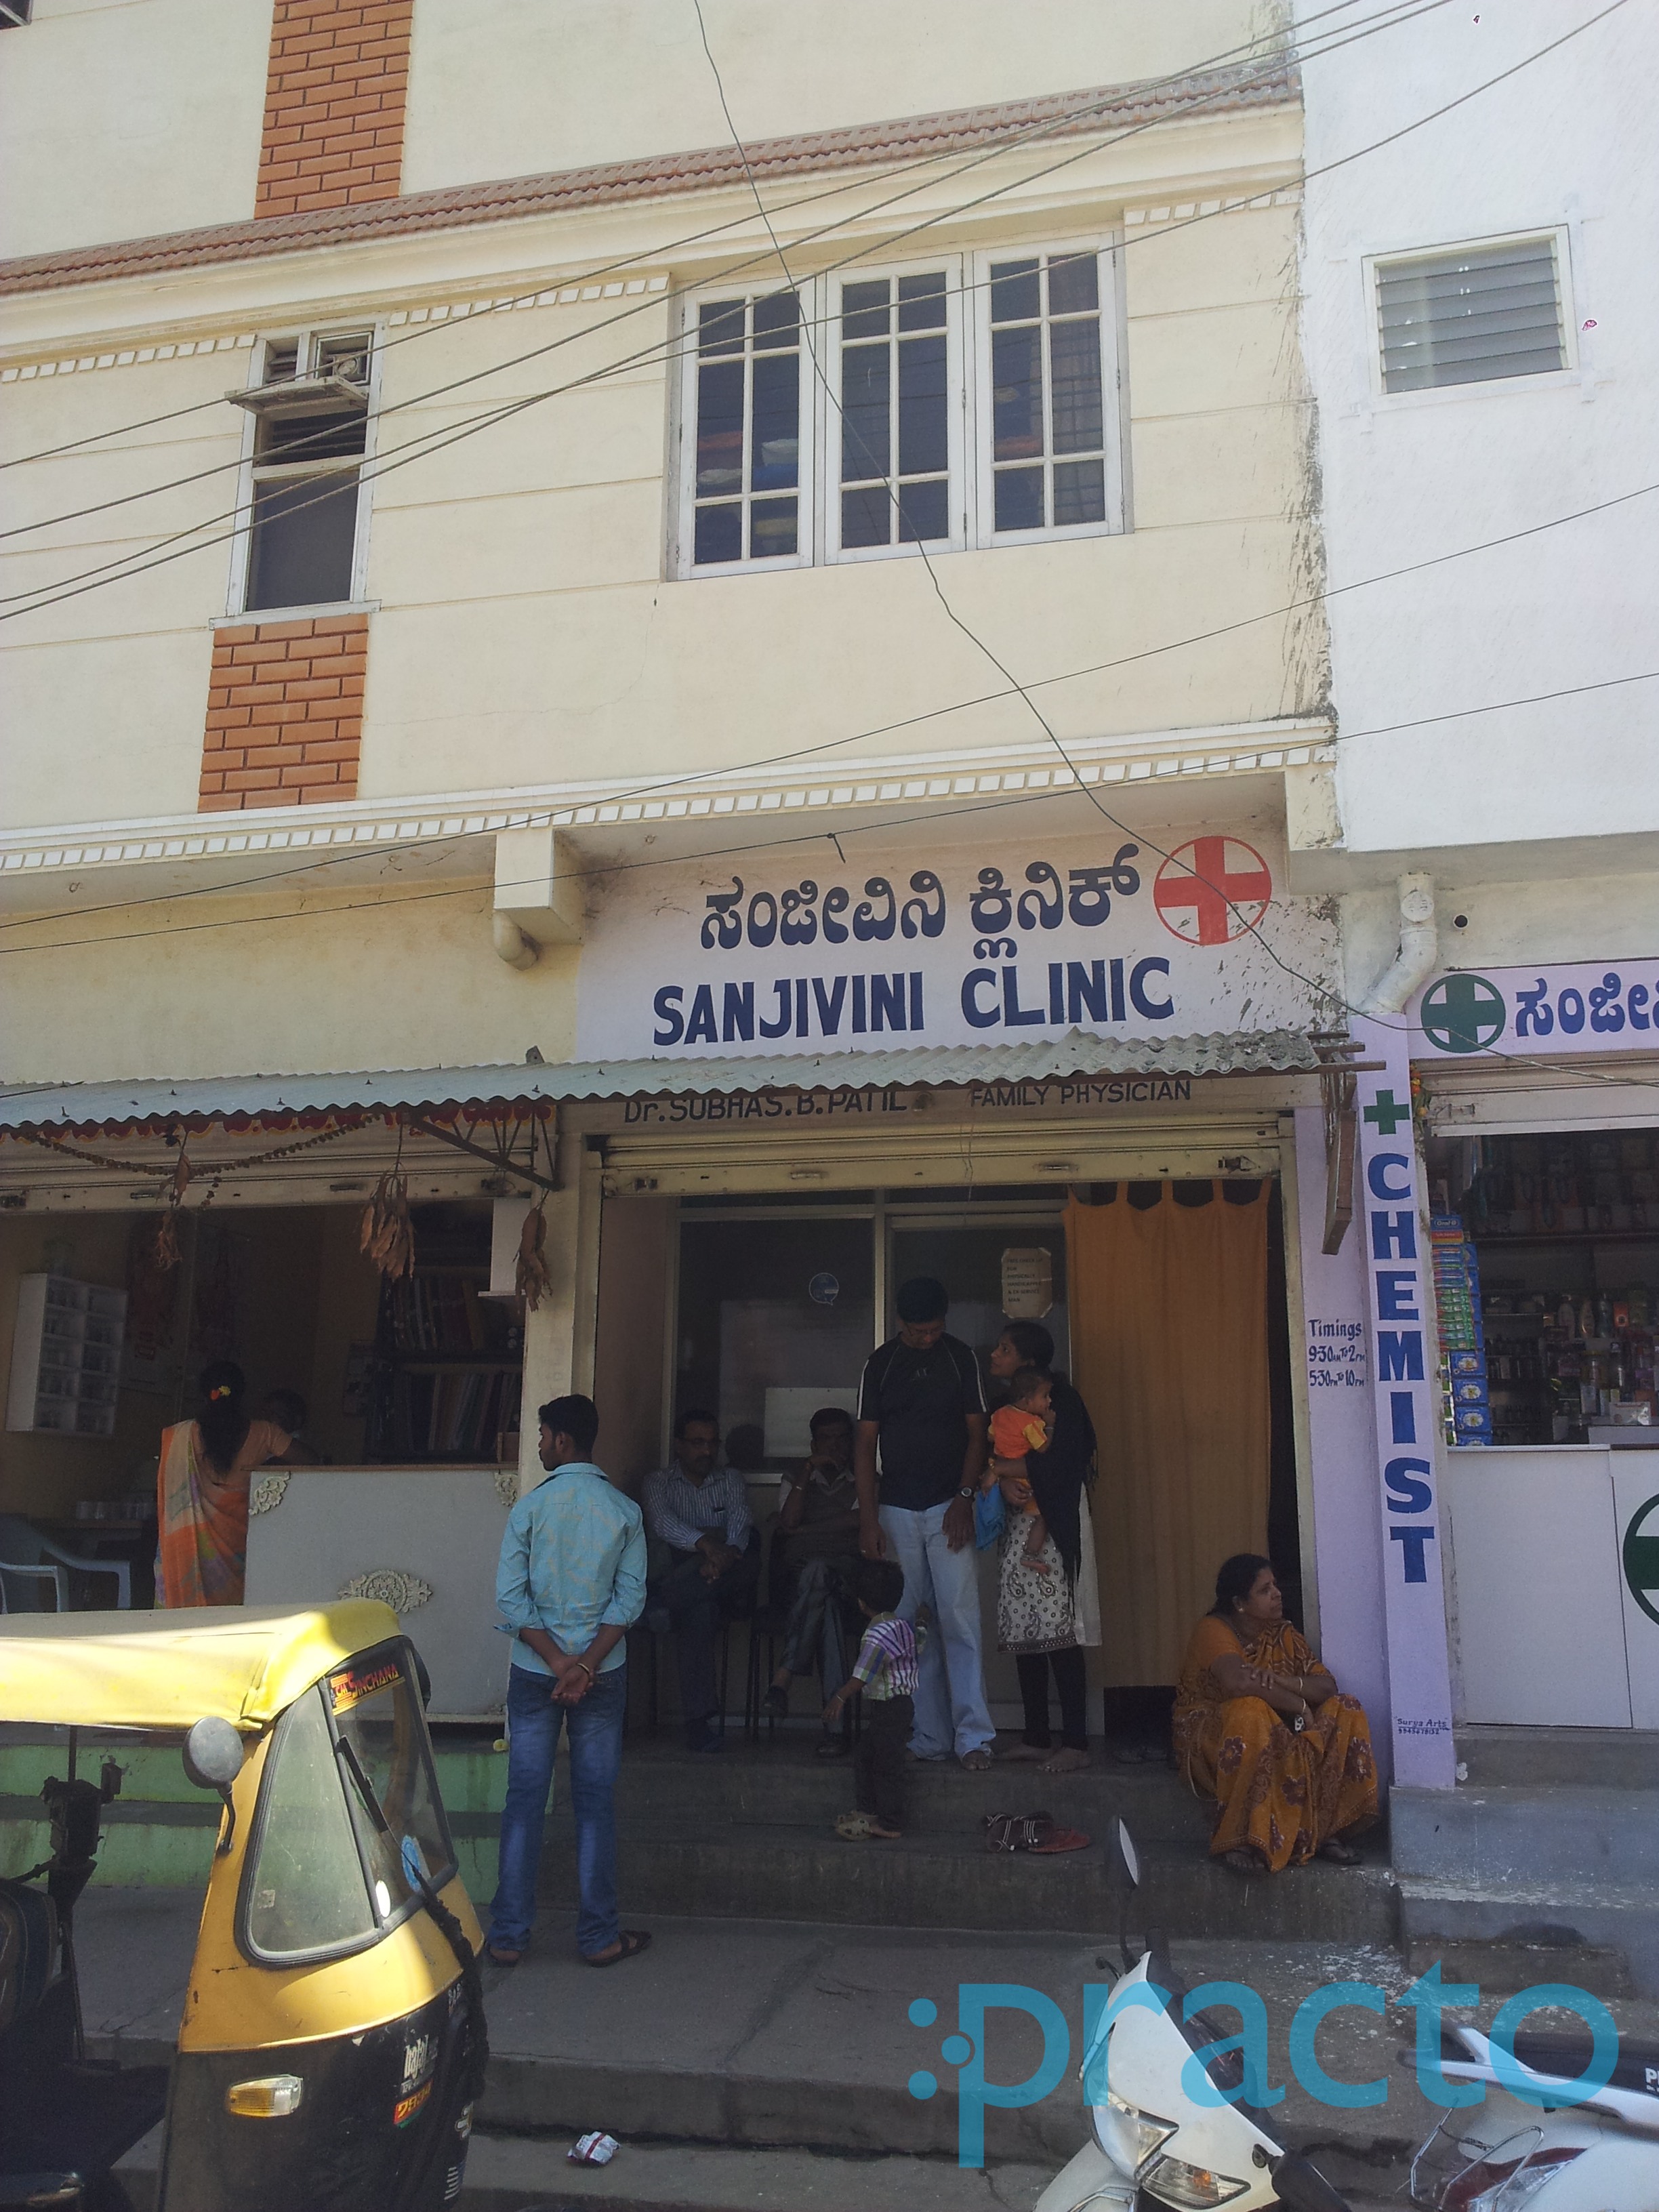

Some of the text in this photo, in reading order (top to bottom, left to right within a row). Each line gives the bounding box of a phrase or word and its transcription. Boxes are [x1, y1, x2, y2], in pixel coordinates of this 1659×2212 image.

[701, 843, 1141, 960] ಸಂಜೀವಿನಿ ಕ್ಲಿನಿಕ್
[653, 956, 1174, 1046] SANJIVINI CLINIC
[1516, 972, 1659, 1037] ಸಂಜೀ
[970, 1080, 1191, 1107] FAMILY PHYSICIAN
[1308, 1319, 1362, 1341] Timings
[1368, 1153, 1435, 1583] CHEMIST
[1645, 2067, 1659, 2086] P
